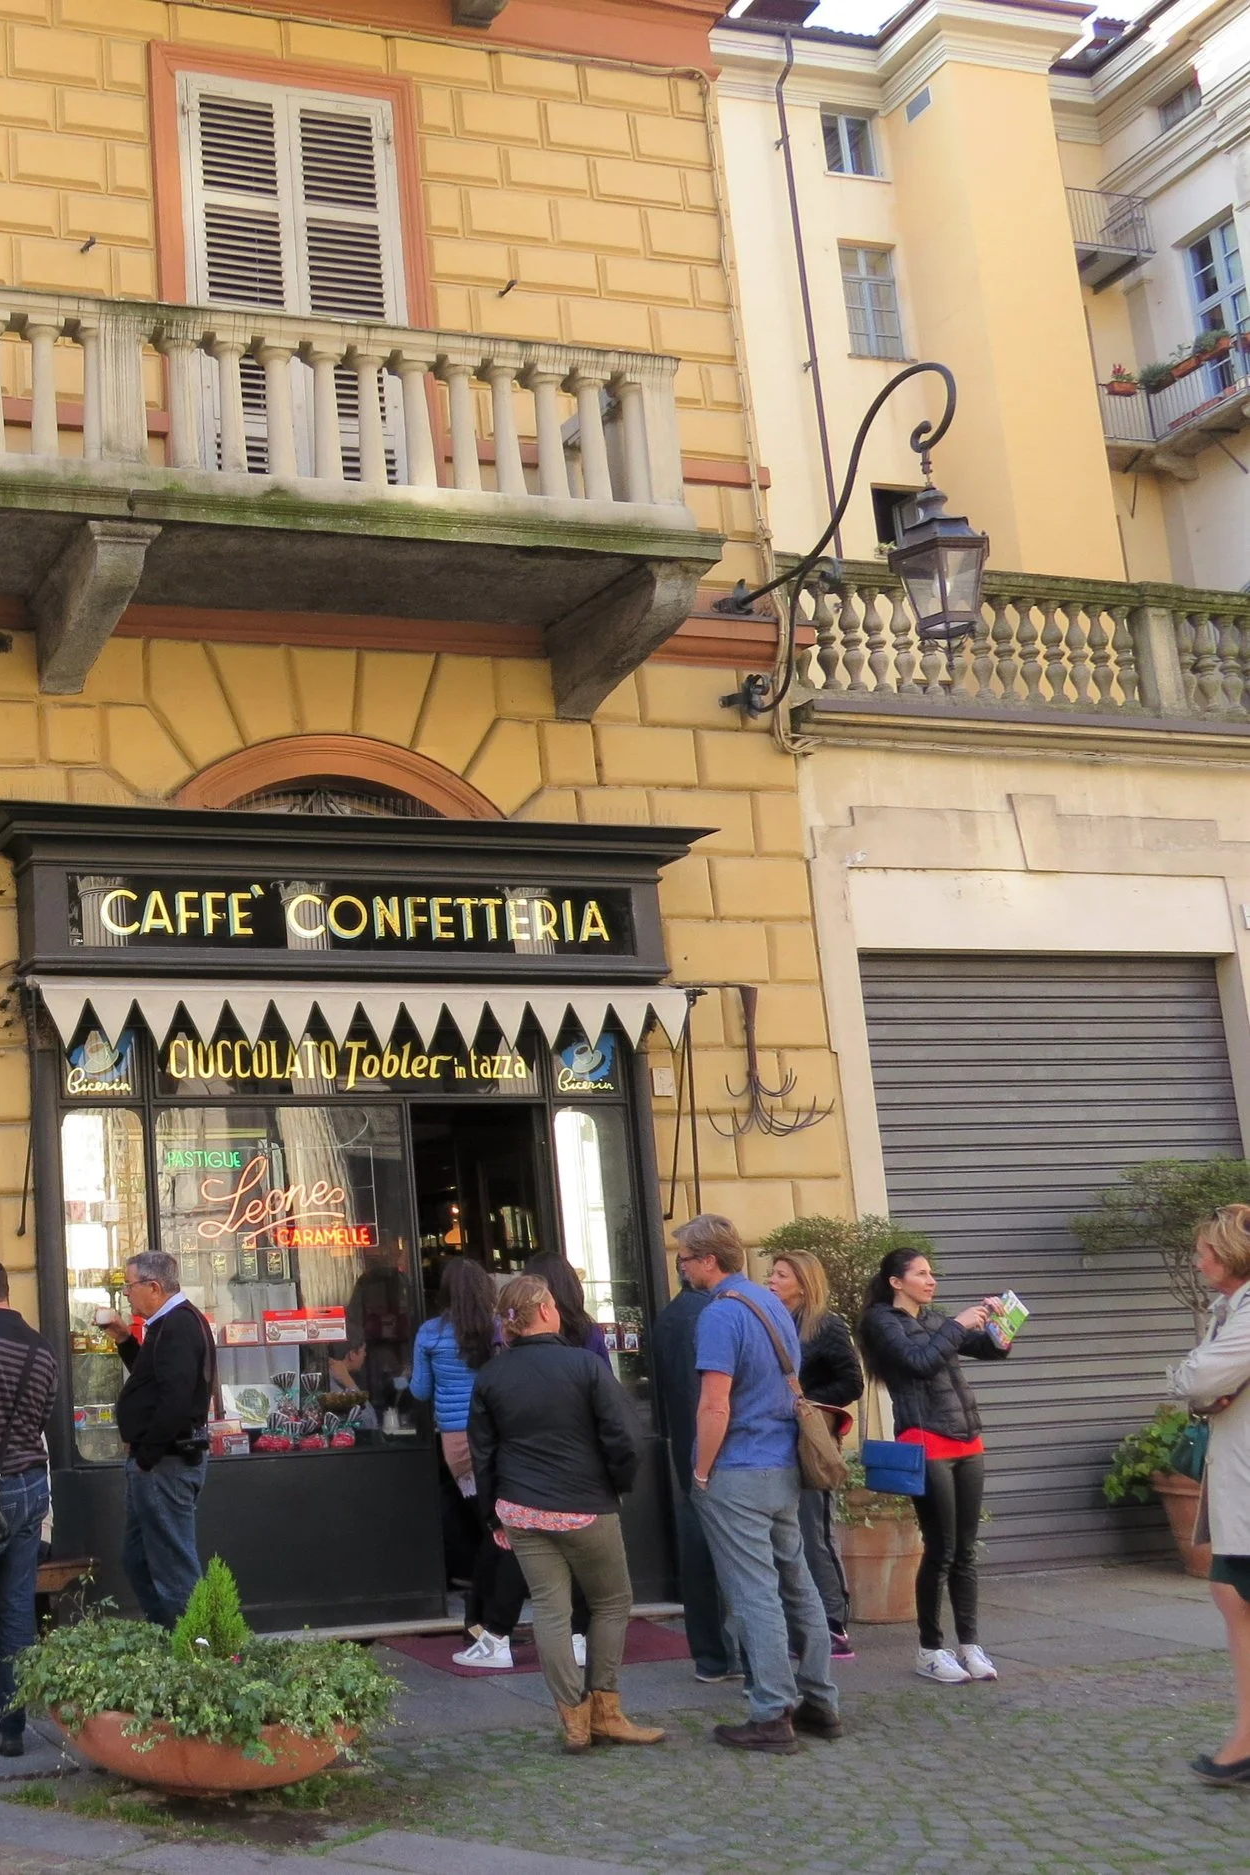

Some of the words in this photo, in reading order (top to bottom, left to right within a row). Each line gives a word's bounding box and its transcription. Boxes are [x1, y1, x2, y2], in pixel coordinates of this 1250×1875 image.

[286, 893, 610, 943] CONFETTERIA
[169, 1039, 337, 1080] CIOCCOLATO
[344, 1041, 453, 1090] Tobler
[454, 1057, 467, 1079] in
[470, 1048, 527, 1079] tazza
[66, 1068, 132, 1094] Bicerin
[557, 1067, 615, 1091] Bicerin
[276, 1227, 370, 1246] CARAMELLE
